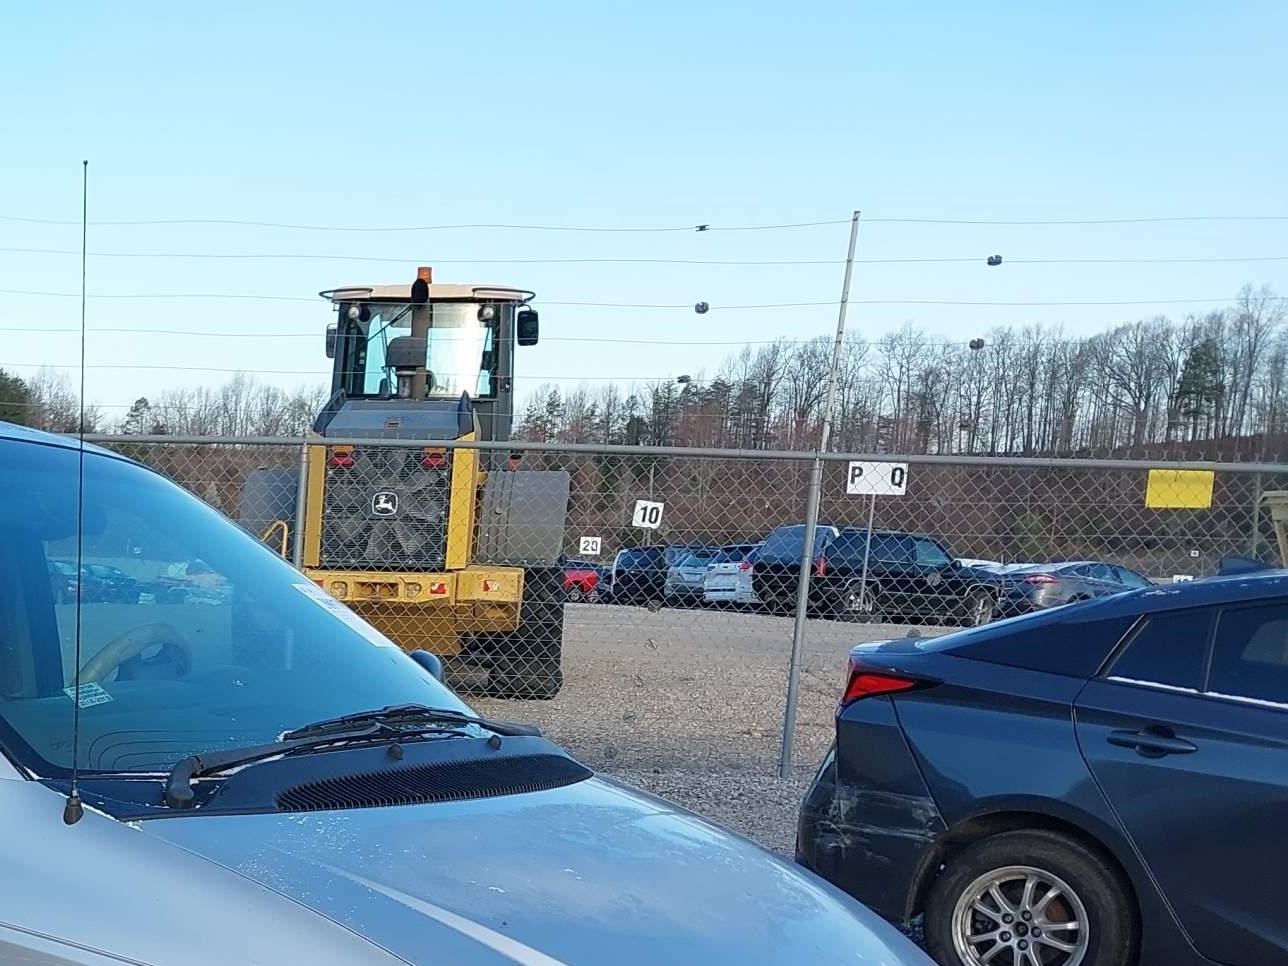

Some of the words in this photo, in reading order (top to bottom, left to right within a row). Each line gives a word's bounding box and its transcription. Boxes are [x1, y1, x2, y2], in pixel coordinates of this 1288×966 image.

[850, 466, 864, 484] P
[891, 467, 905, 488] Q
[640, 506, 660, 524] 10
